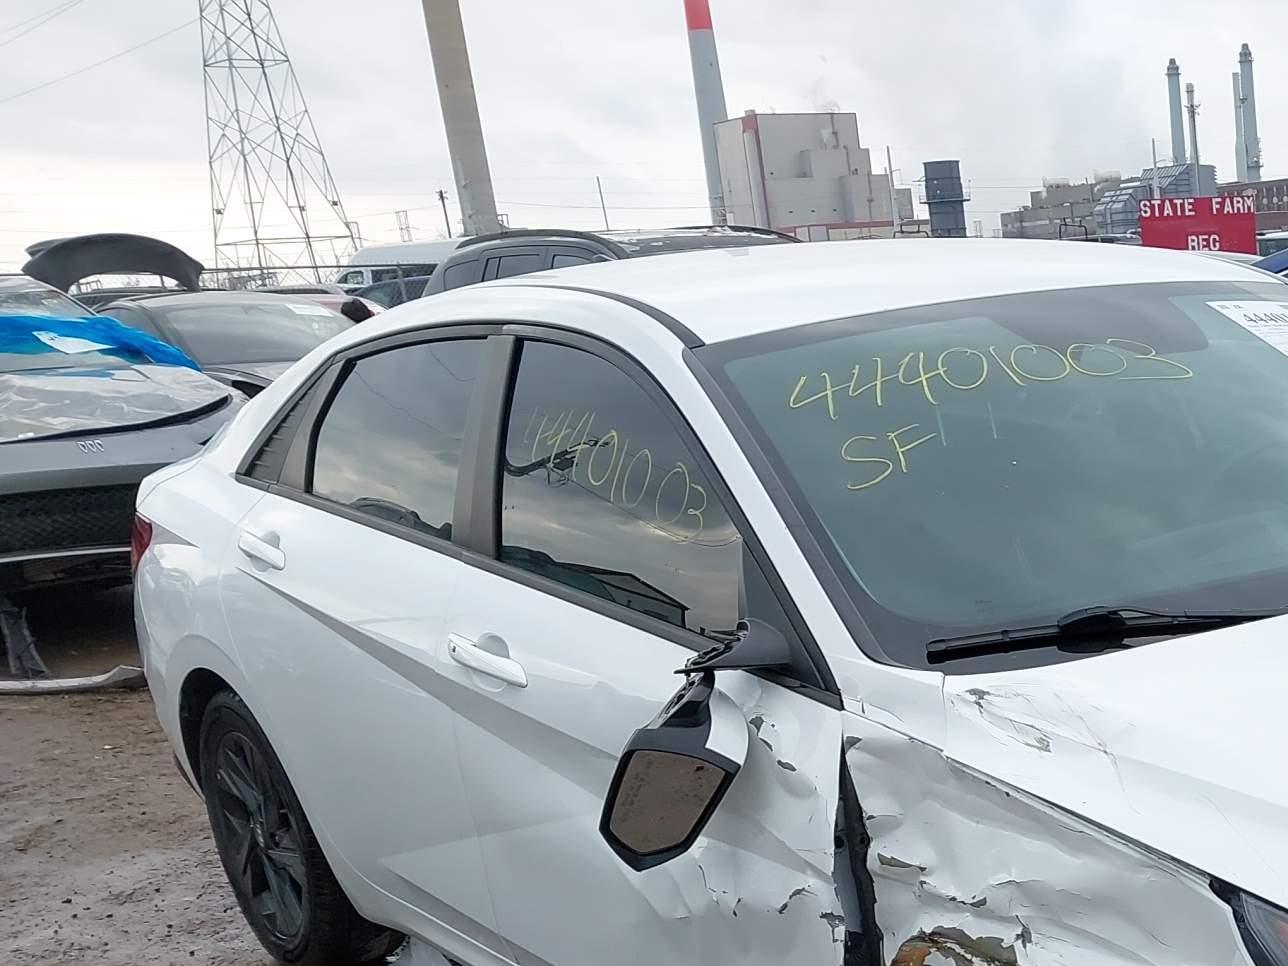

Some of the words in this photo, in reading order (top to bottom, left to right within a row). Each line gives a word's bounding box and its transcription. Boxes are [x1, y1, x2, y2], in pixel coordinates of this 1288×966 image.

[1139, 198, 1196, 218] STATE
[1211, 195, 1255, 216] FARM
[1187, 234, 1221, 252] REG
[789, 338, 1193, 421] 44401003
[841, 423, 937, 490] SF
